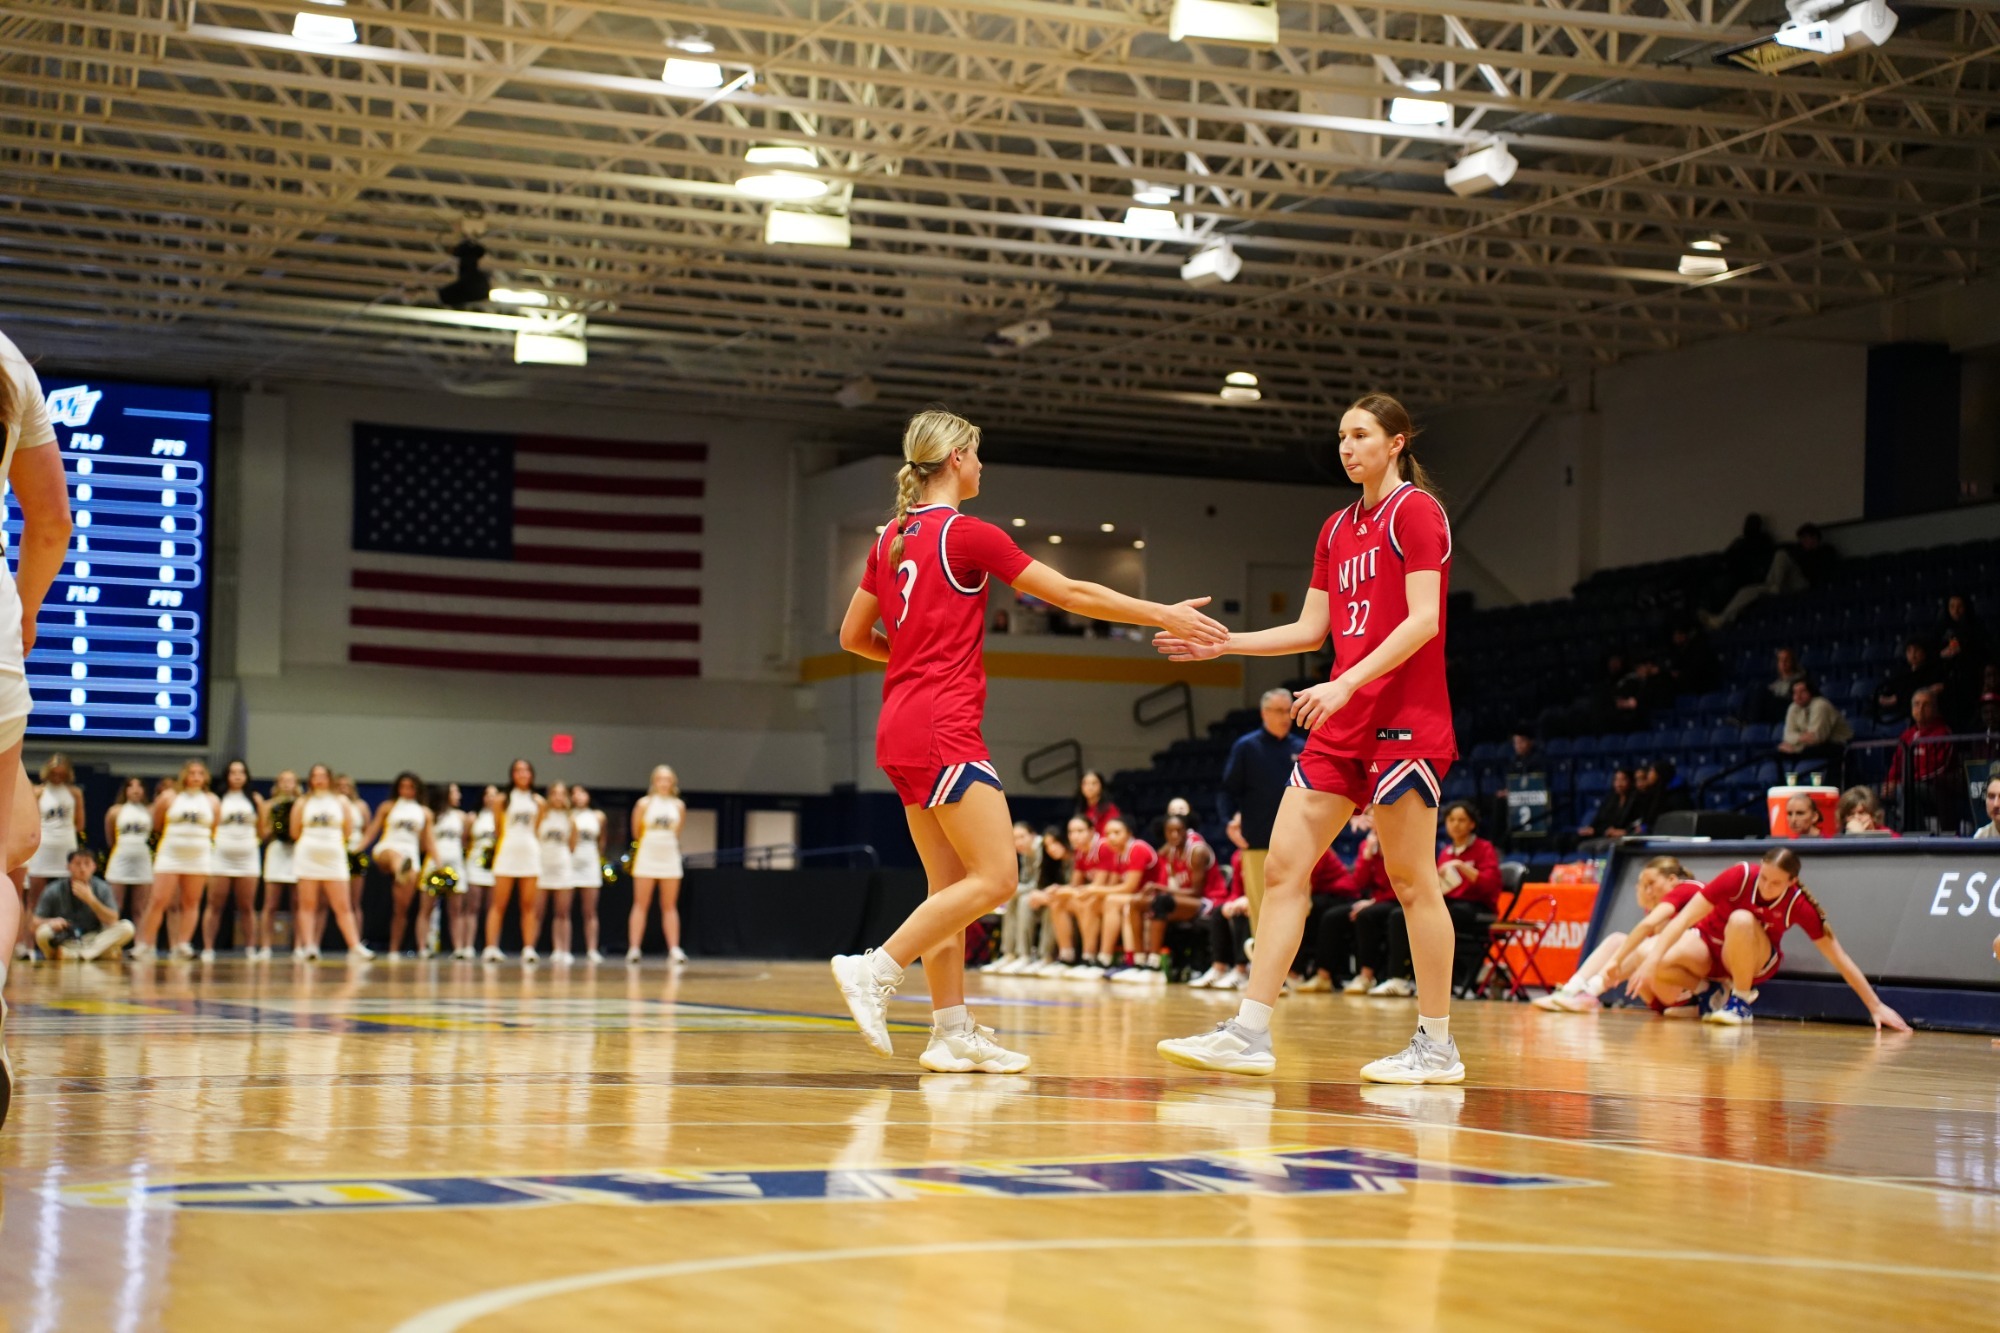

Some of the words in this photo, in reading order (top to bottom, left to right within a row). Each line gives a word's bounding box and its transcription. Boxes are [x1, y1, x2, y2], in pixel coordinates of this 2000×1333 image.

[70, 433, 103, 450] FLS
[152, 438, 187, 456] PTS
[78, 536, 88, 552] 1
[1338, 546, 1380, 597] NJIT
[67, 585, 100, 602] FLS
[148, 590, 183, 607] PTS
[75, 610, 86, 626] 1
[158, 614, 172, 631] 4
[1342, 600, 1371, 637] 32
